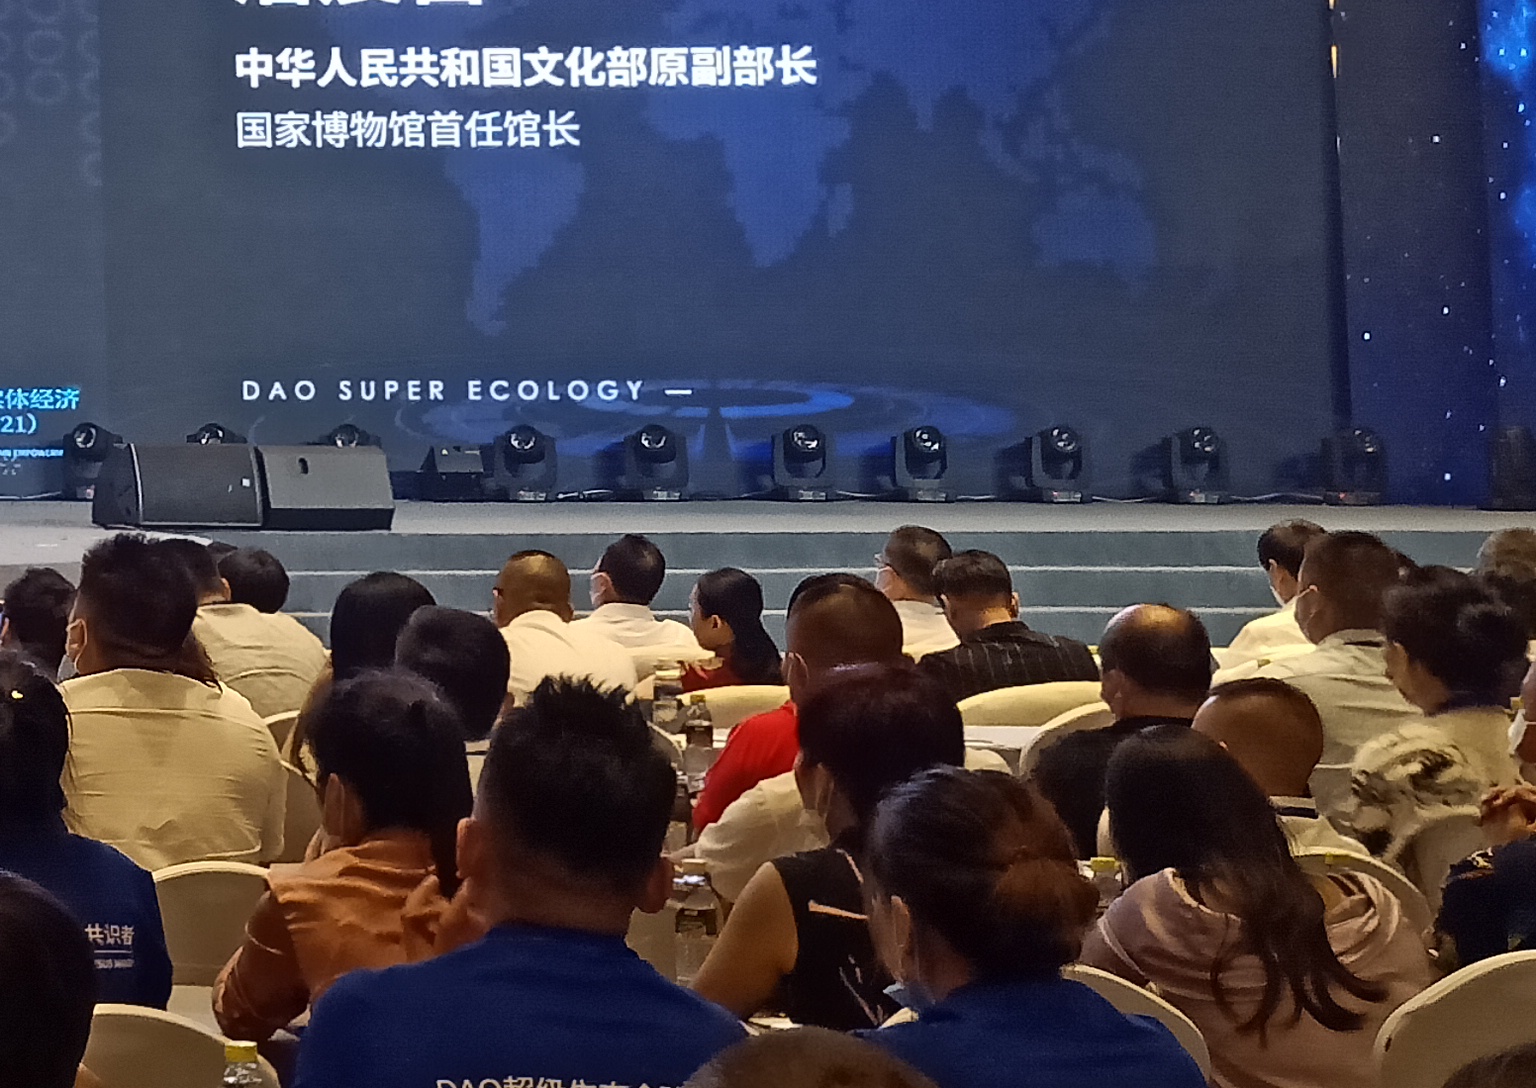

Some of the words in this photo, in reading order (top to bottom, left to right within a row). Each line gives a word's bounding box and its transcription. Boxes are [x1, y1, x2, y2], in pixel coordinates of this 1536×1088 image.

[235, 44, 818, 89] 中华人民共和国文化部原副部长
[236, 109, 582, 149] 国家博物馆首任馆长
[242, 380, 316, 401] DAO
[338, 380, 445, 401] SUPER
[468, 380, 643, 401] ECOLOGY
